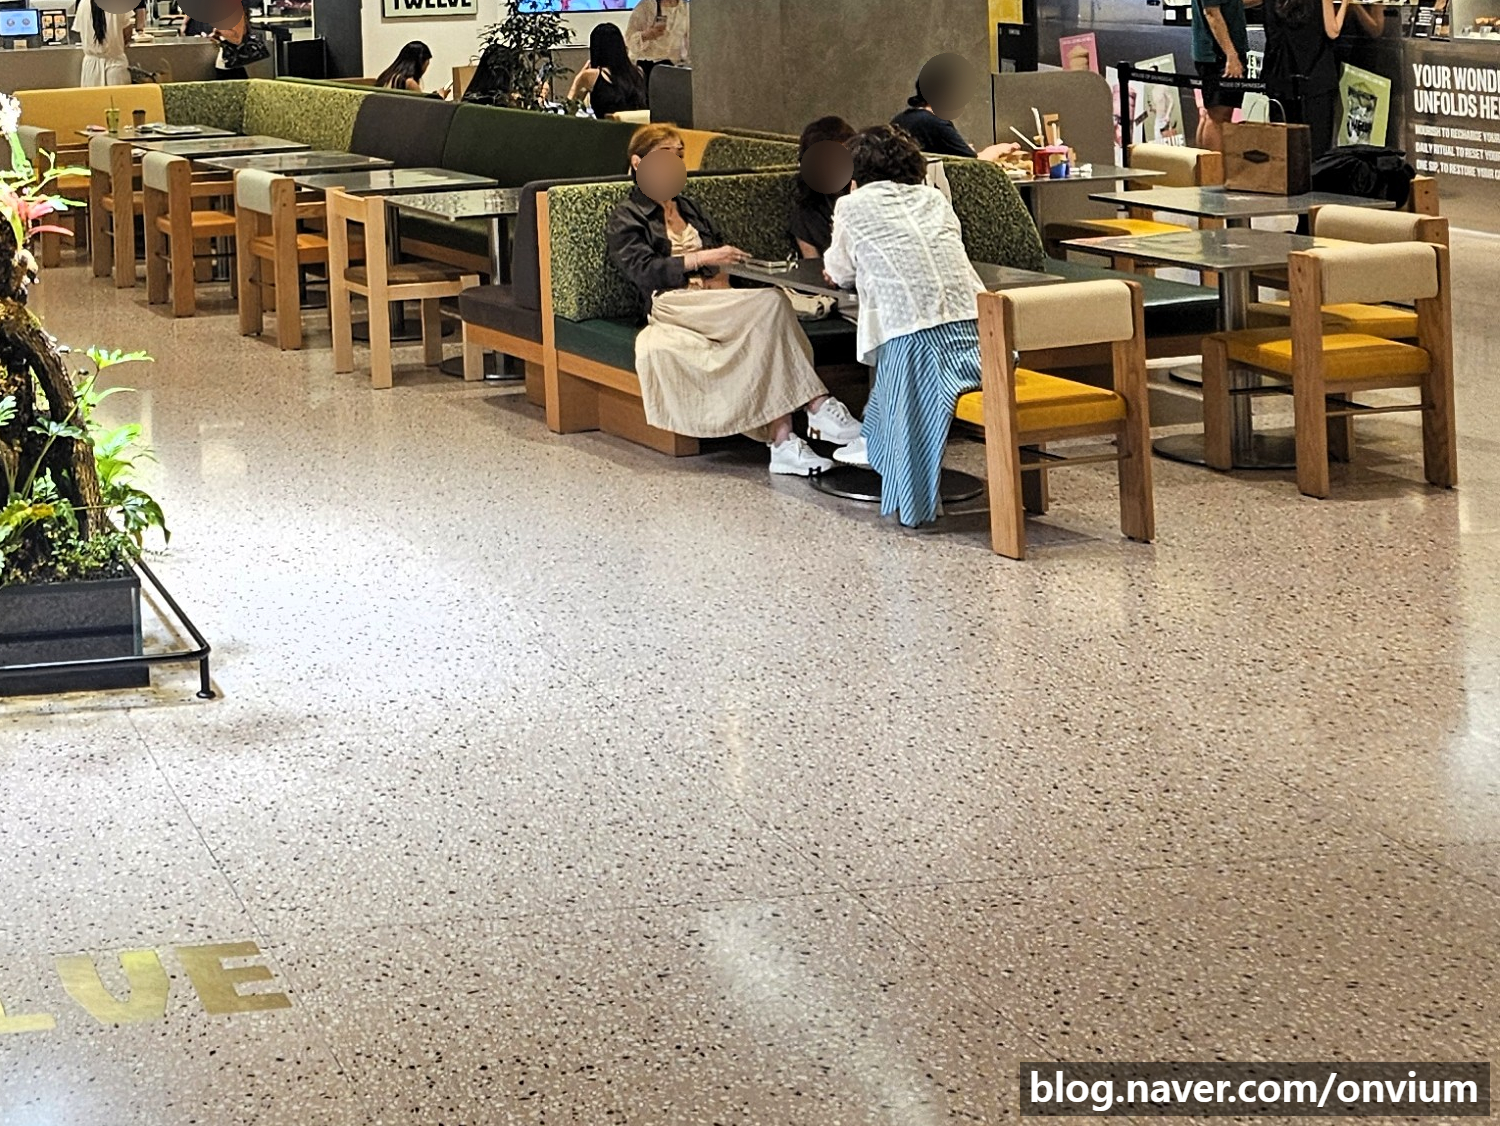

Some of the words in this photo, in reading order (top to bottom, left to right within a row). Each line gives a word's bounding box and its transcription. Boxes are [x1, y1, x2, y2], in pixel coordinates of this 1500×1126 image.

[1412, 63, 1451, 90] YOUR
[1413, 89, 1478, 118] UNFOLDS
[1480, 95, 1500, 121] HE
[1441, 127, 1450, 138] TO
[1415, 141, 1433, 154] DAILY
[1433, 143, 1456, 157] RITUAL
[1456, 146, 1464, 158] TO
[1464, 147, 1484, 160] RESET
[1440, 162, 1449, 174] TO
